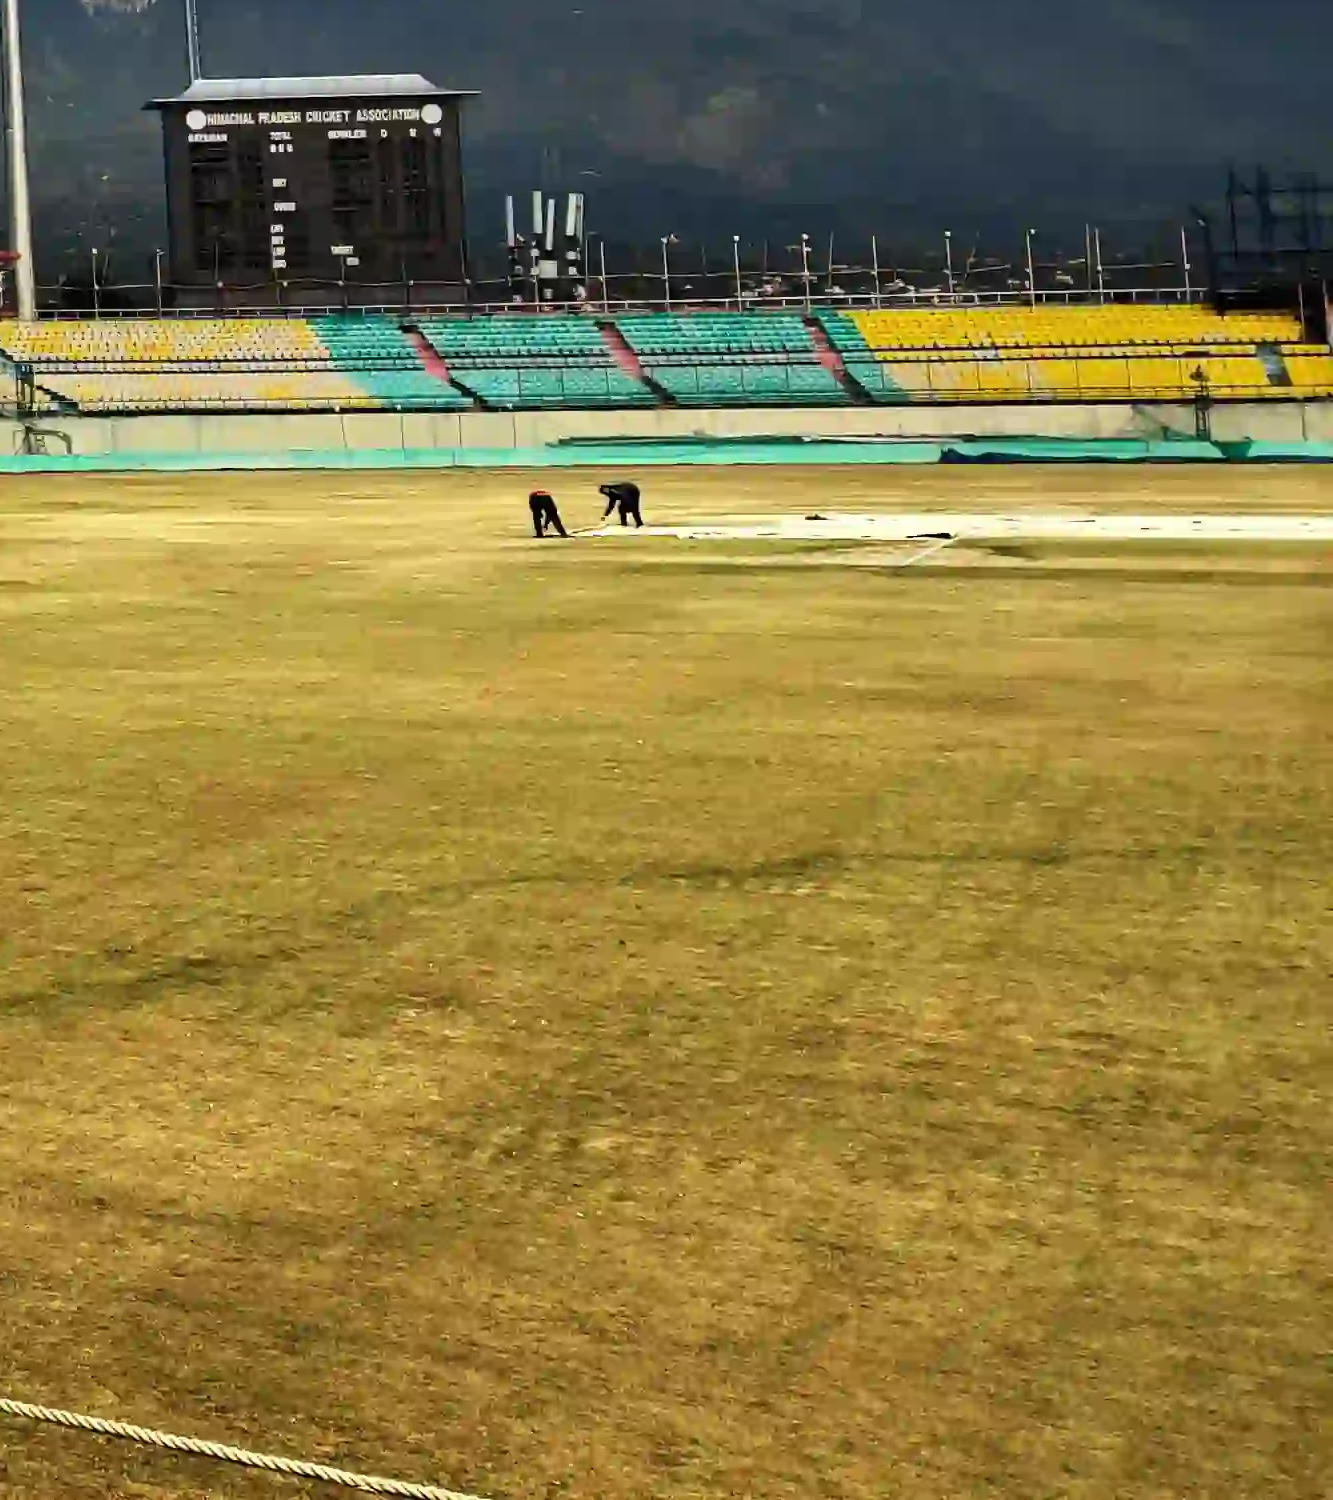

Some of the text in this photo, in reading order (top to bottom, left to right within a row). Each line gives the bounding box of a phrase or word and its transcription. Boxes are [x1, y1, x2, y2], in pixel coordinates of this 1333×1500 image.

[207, 108, 420, 125] HIMACHAL PRADESH CRICKET ASSOCIATION
